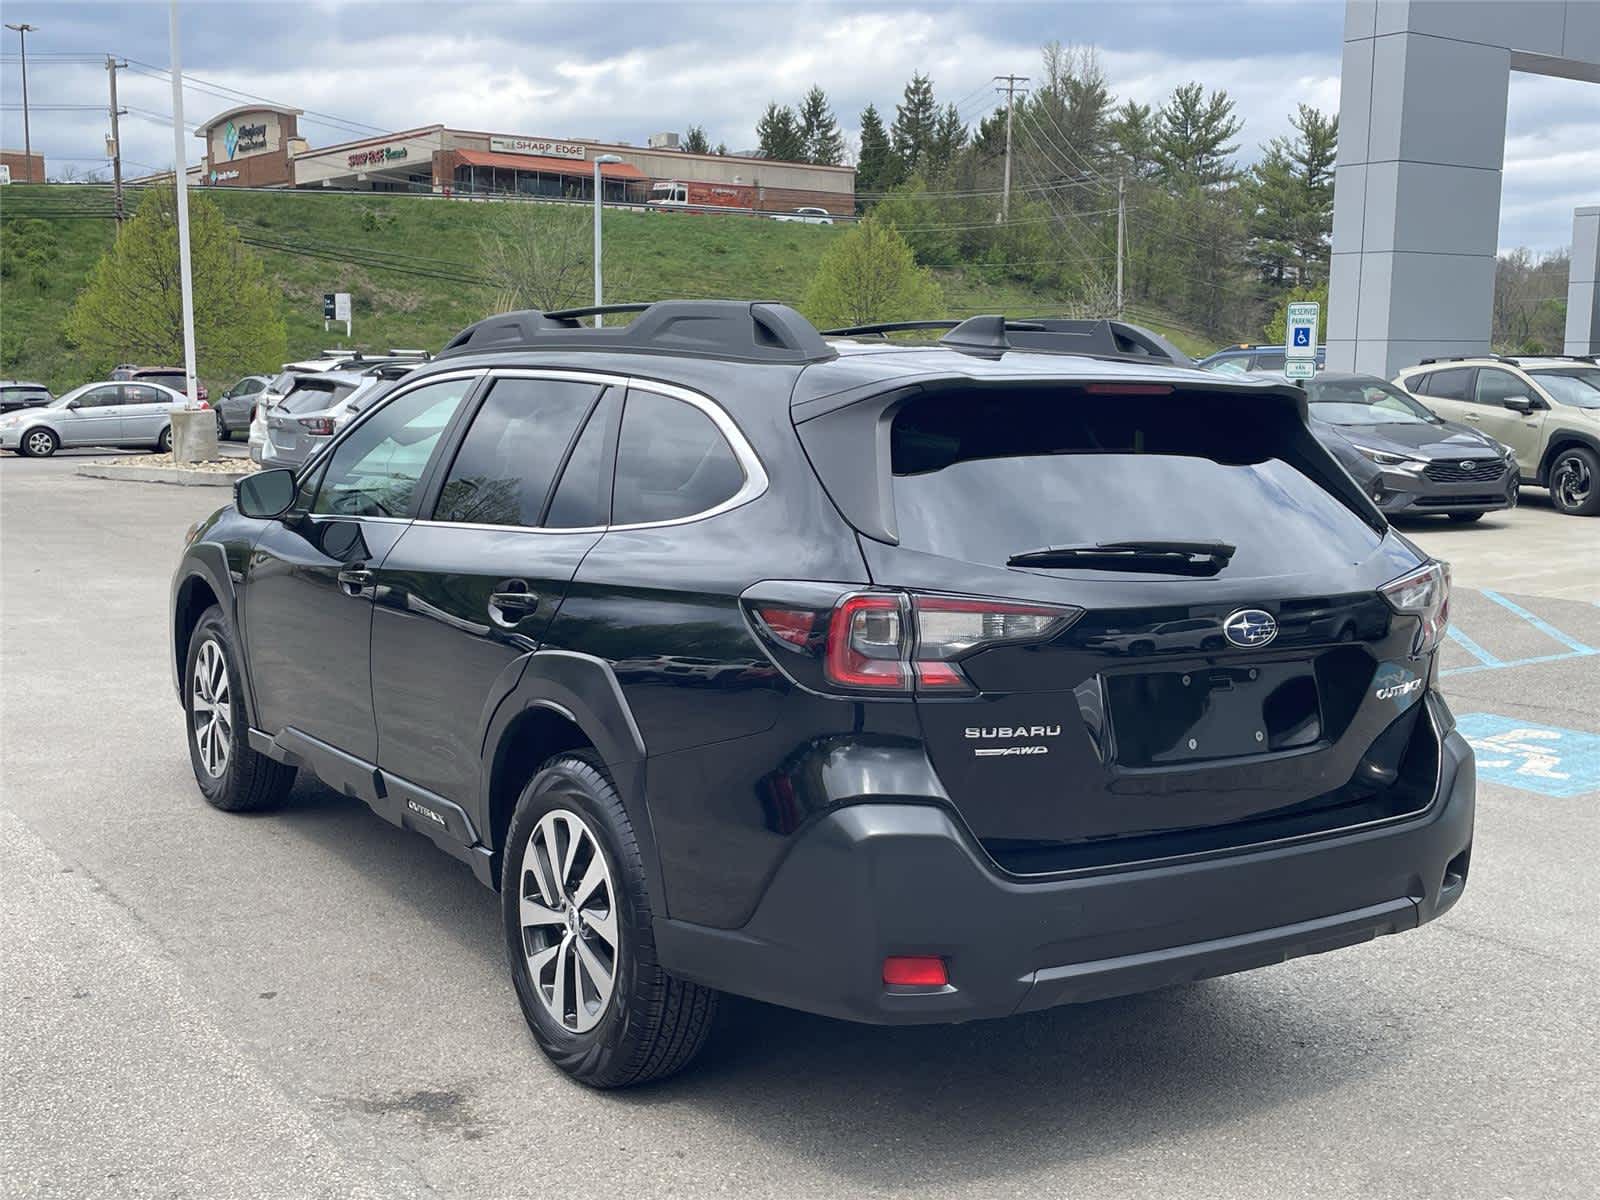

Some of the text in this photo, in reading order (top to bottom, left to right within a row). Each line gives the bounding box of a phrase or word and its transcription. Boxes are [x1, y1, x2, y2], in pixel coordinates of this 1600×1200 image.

[516, 141, 552, 152] SHARP
[555, 144, 583, 155] EDGE
[1375, 677, 1422, 700] OUTBACK
[964, 724, 1061, 738] SUBARU
[1003, 745, 1049, 756] AWD
[407, 800, 446, 825] OUTBACK
